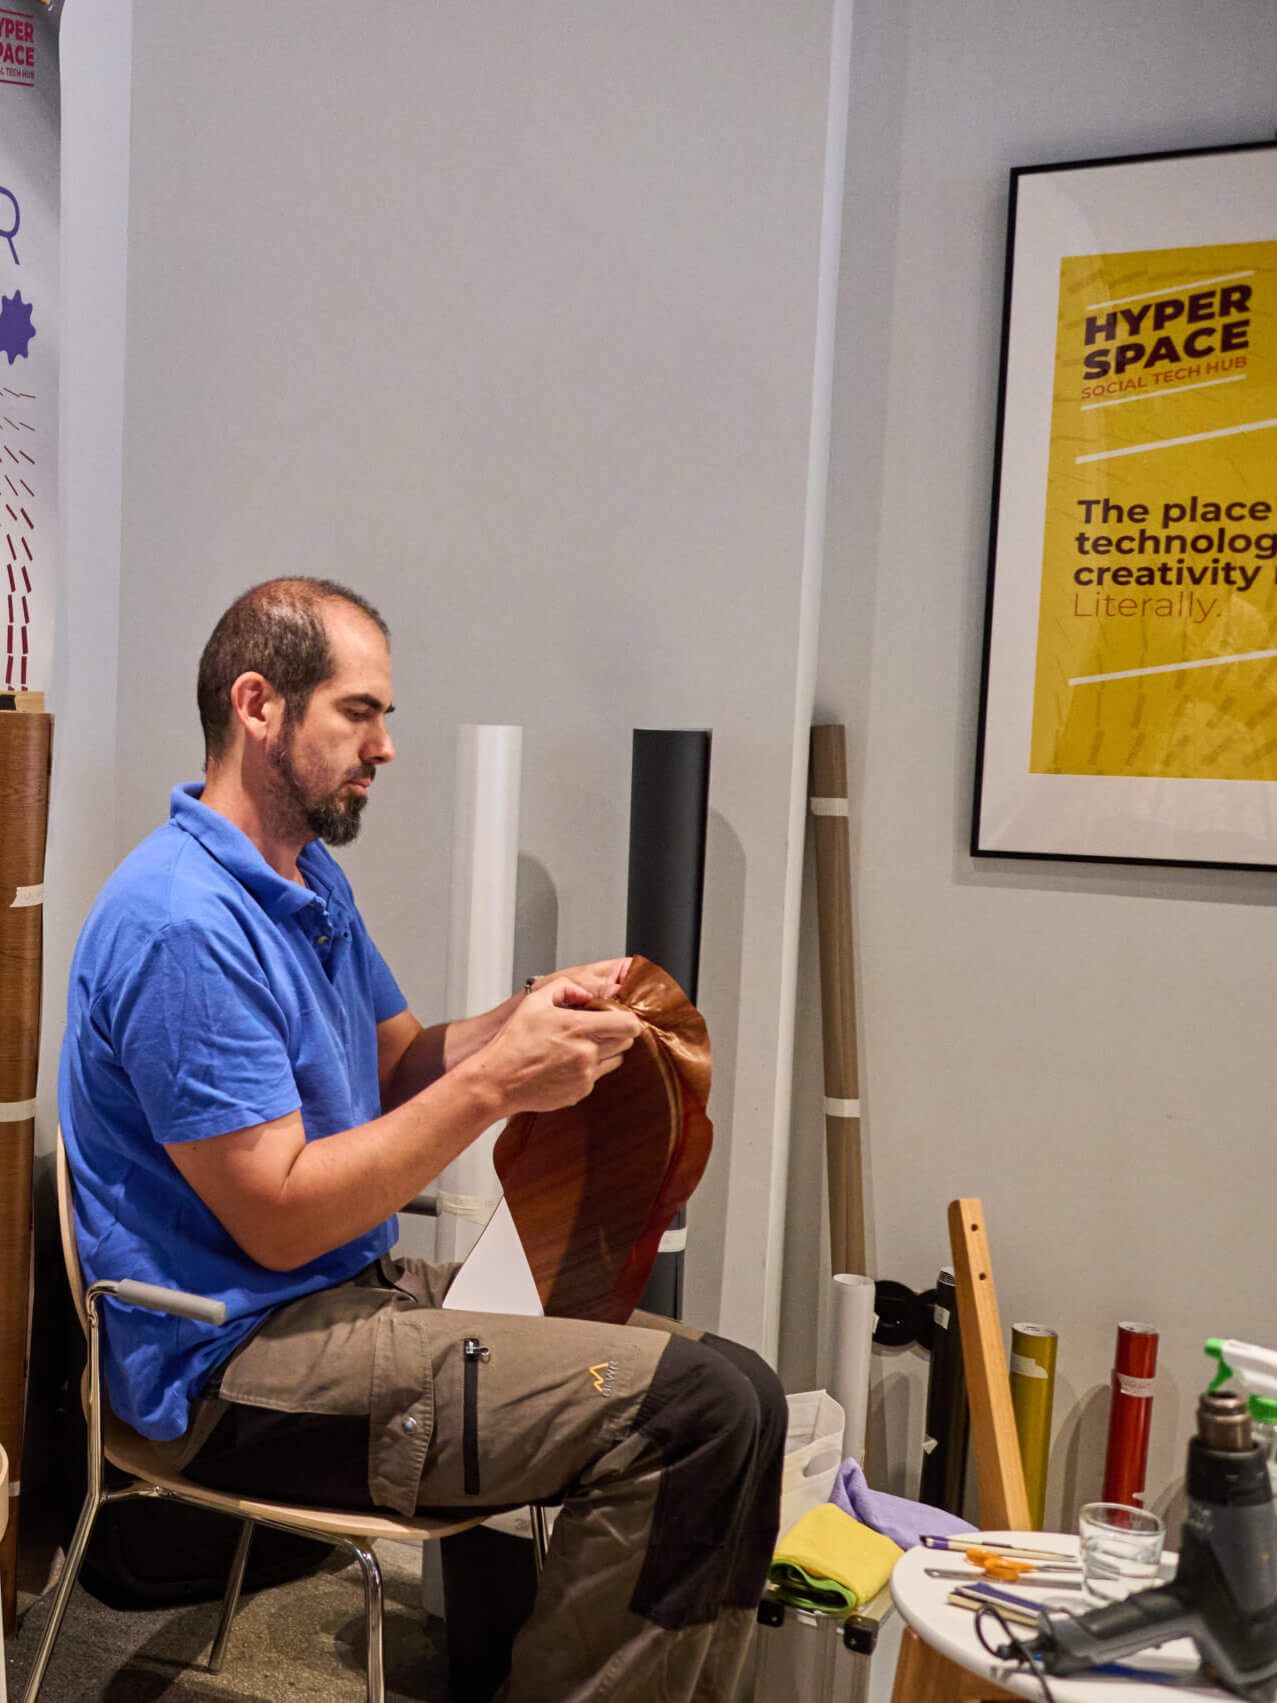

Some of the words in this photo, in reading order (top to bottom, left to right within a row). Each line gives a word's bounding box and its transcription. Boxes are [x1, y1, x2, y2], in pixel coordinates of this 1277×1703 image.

[1084, 284, 1253, 346] HYPER
[1082, 319, 1251, 380] SPACE
[1080, 379, 1147, 400] SOCIAL
[1152, 366, 1201, 386] TECH
[1205, 355, 1248, 375] HUB
[1077, 498, 1150, 524] The
[1162, 496, 1272, 529] place
[1075, 527, 1277, 560] technolog
[1073, 558, 1262, 592] creativity
[1073, 591, 1222, 624] Literally.
